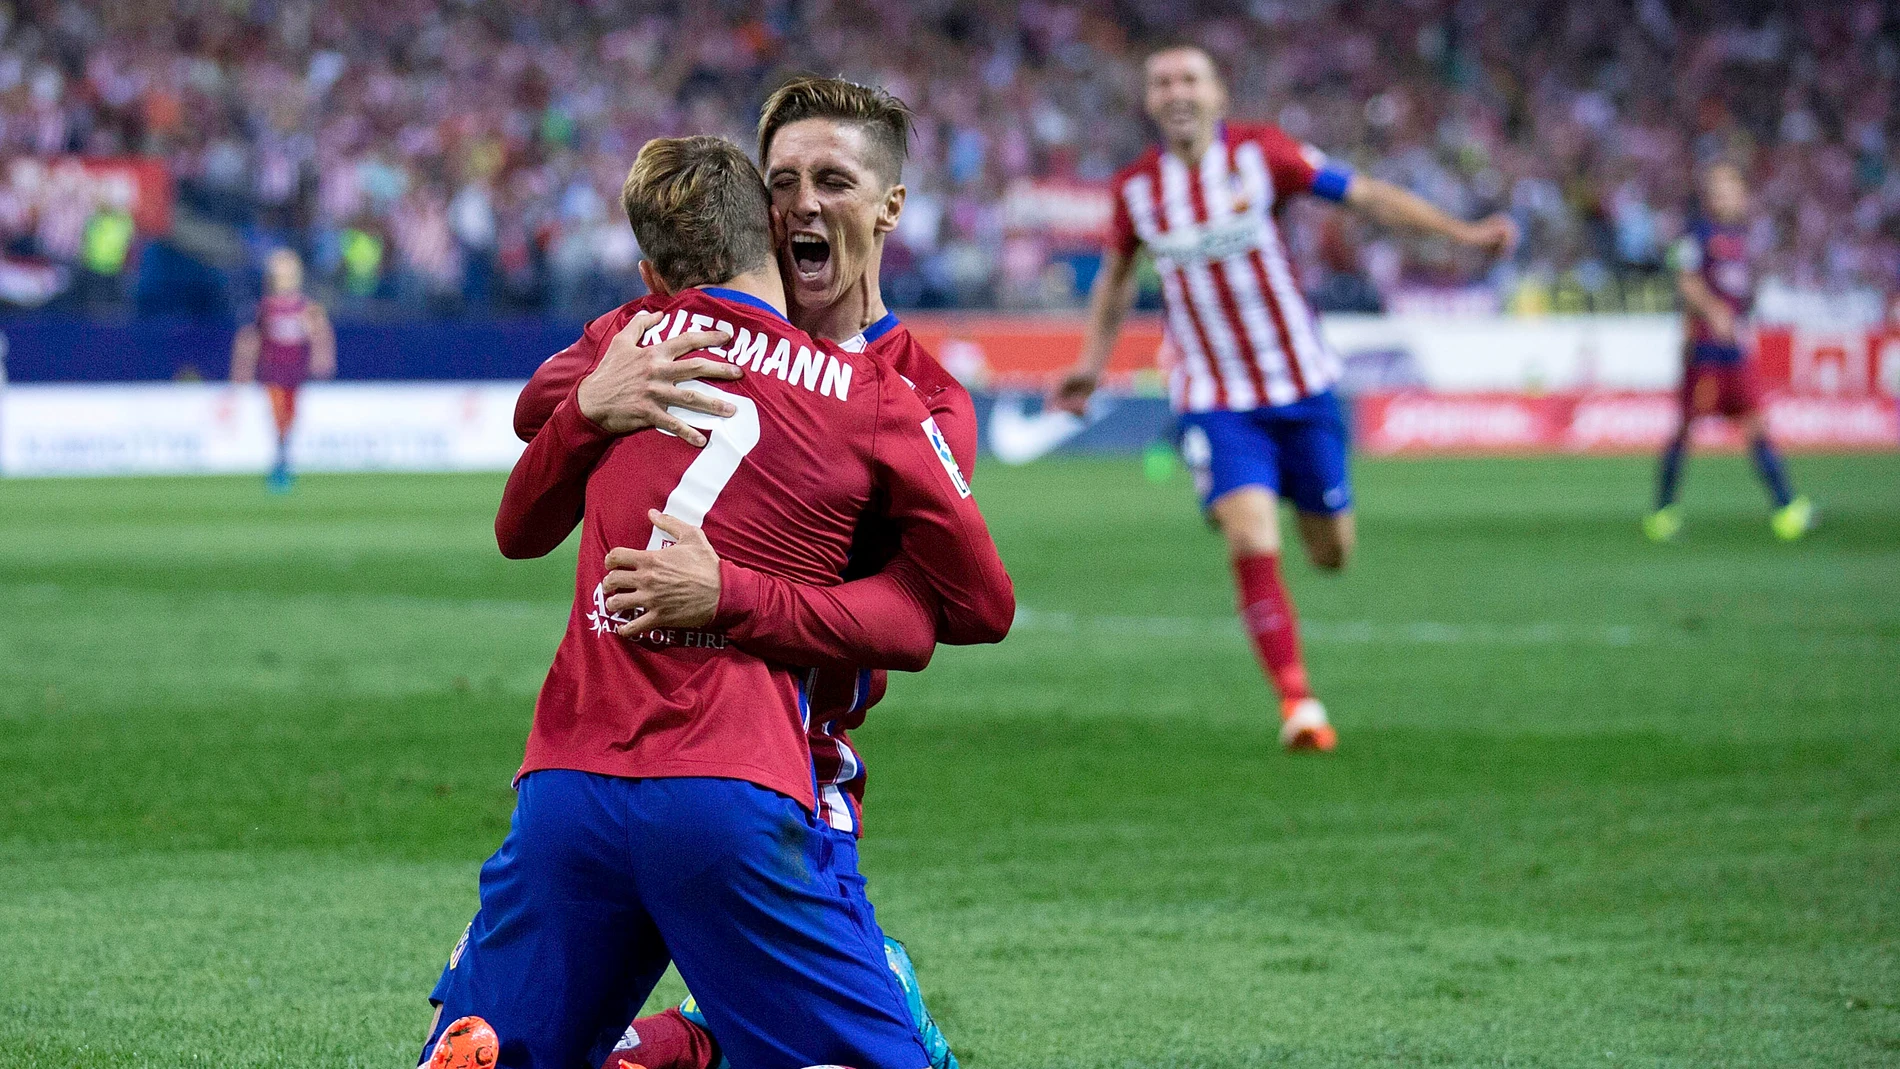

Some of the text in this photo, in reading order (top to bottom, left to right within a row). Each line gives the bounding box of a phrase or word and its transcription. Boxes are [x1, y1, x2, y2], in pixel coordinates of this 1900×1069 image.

[637, 309, 853, 402] RIEZMANN
[646, 378, 761, 550] 7
[650, 628, 676, 646] OF
